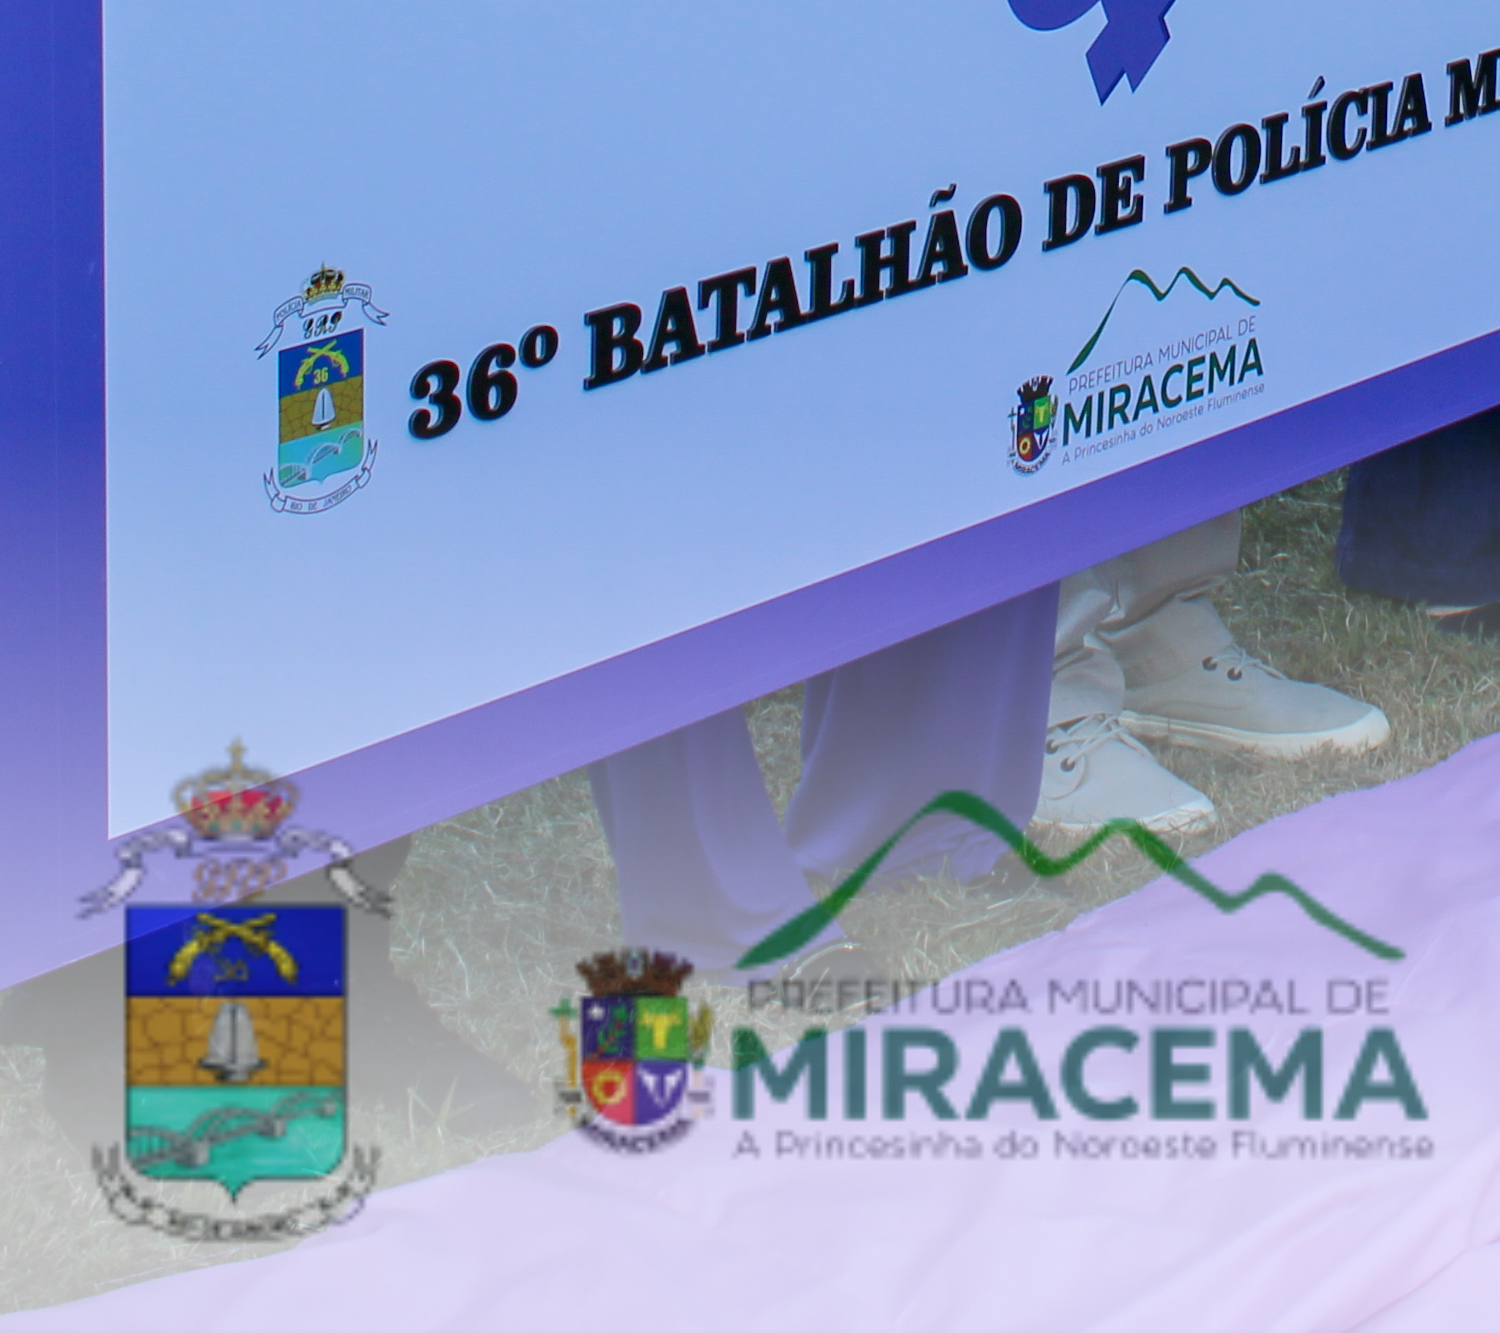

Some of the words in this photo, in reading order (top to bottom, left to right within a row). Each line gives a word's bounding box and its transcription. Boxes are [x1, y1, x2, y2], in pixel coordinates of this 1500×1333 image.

[582, 184, 1023, 391] BATALHÃO
[1041, 153, 1145, 254] DE
[1164, 75, 1430, 216] POLÍCIA
[313, 367, 329, 384] 36
[1062, 337, 1264, 447] MIRACEMA
[1069, 351, 1154, 395] PREFEITURA
[1158, 325, 1233, 364] MUNICIPAL
[1238, 315, 1256, 337] DE
[1061, 451, 1071, 466] A
[1074, 429, 1136, 465] Princesinha
[1140, 422, 1154, 437] do
[1156, 403, 1204, 431] Noroeste
[1207, 383, 1265, 411] Fluminense
